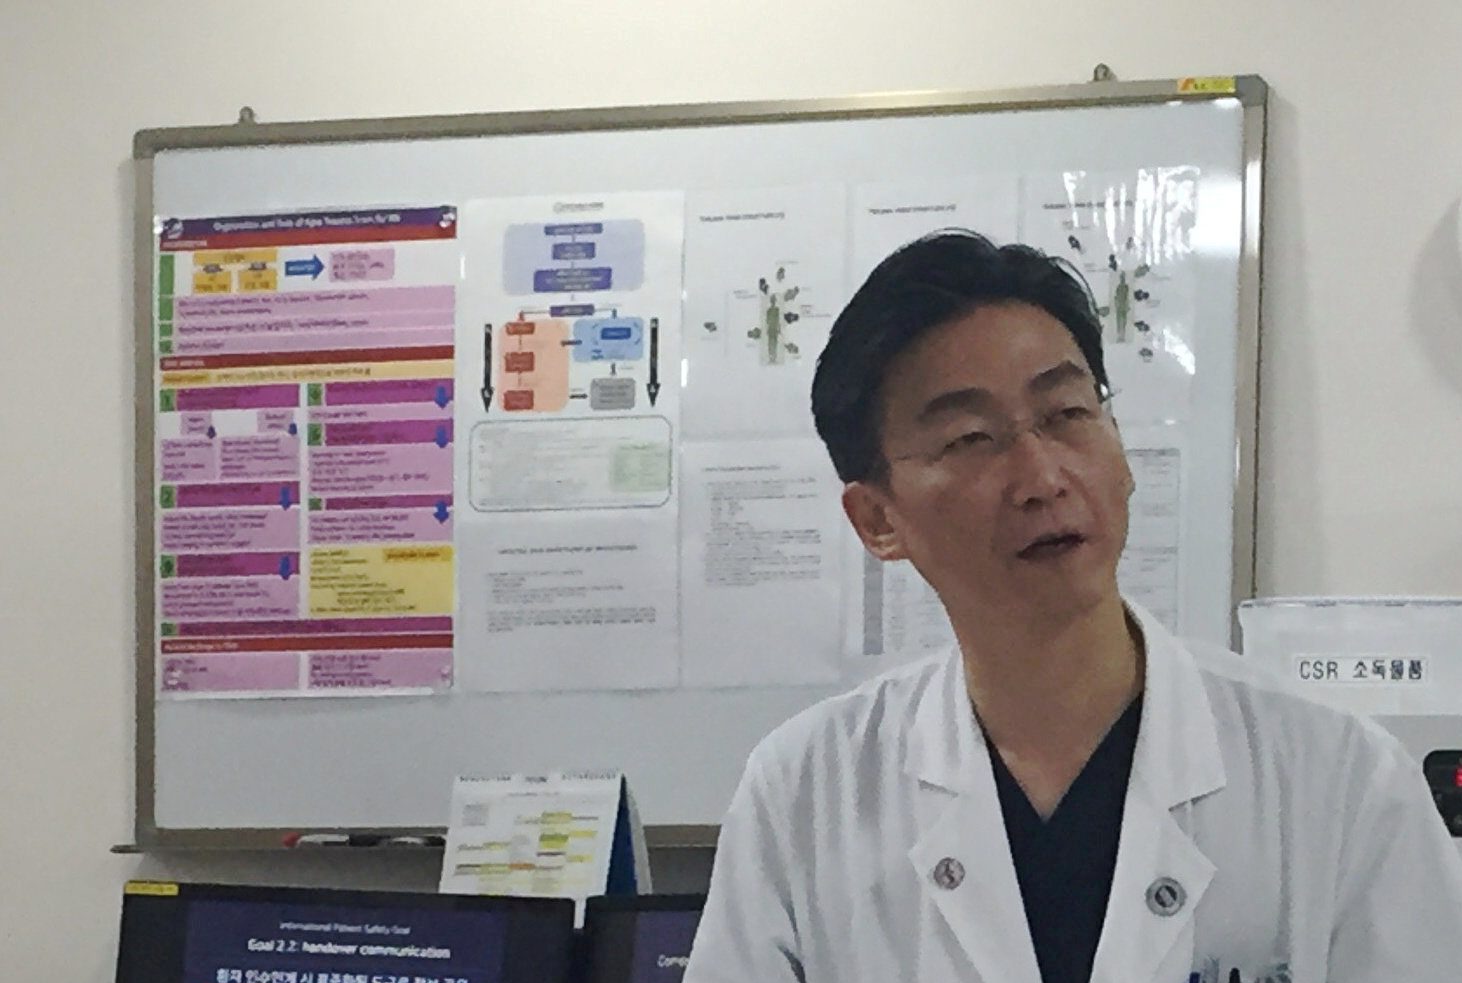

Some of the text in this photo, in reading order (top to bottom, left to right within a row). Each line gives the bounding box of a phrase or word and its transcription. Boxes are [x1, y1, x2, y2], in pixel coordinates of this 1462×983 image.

[1299, 660, 1338, 680] CSR
[247, 938, 275, 951] Goal
[302, 941, 358, 955] handover
[359, 944, 451, 959] communication
